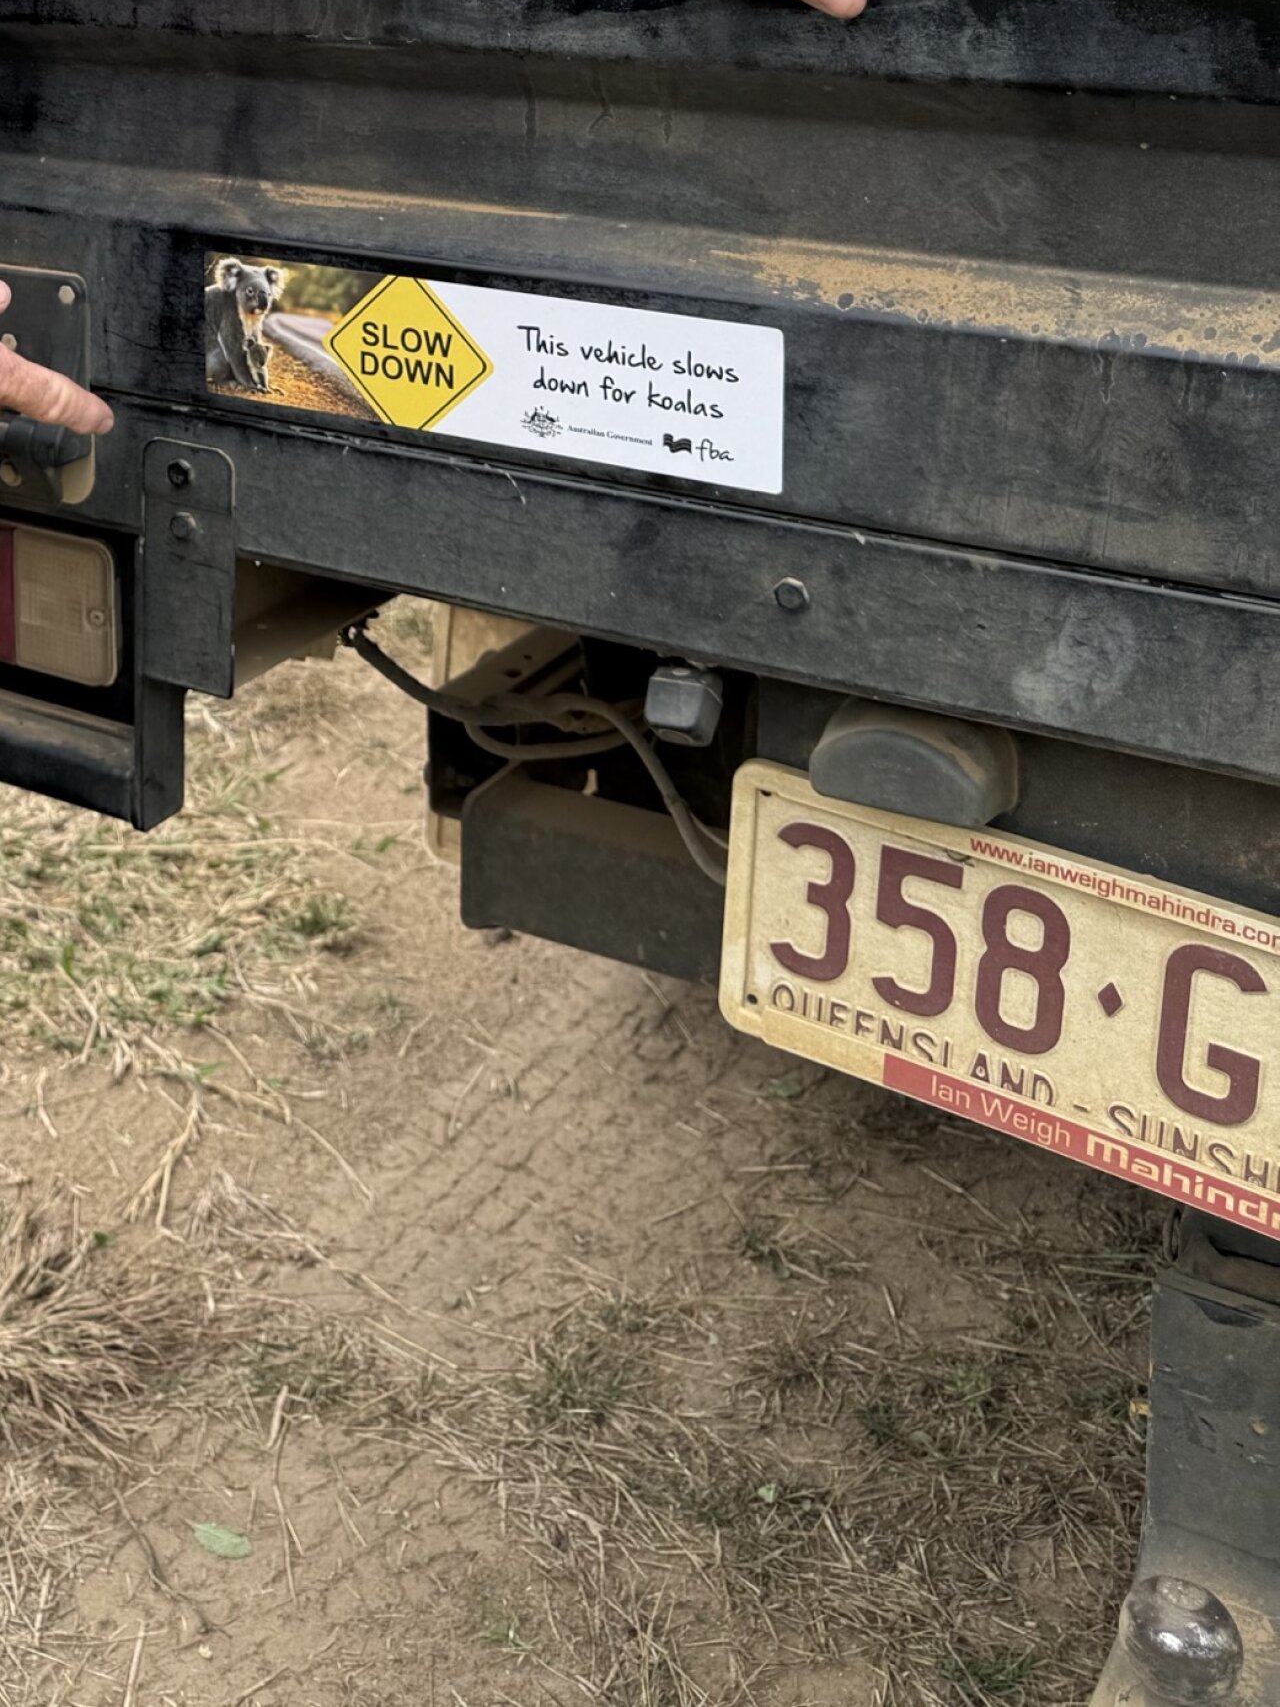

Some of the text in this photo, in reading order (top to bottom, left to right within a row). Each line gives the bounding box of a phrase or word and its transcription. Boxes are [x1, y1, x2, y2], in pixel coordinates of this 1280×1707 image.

[361, 320, 452, 358] SLOW
[517, 325, 739, 383] This vehicle slows
[360, 350, 454, 390] DOWN
[533, 366, 724, 419] down for koalas
[567, 424, 653, 446] Australian Government
[696, 438, 734, 462] fba
[931, 1074, 970, 1109] Ian
[980, 1092, 1071, 1147] Weigh
